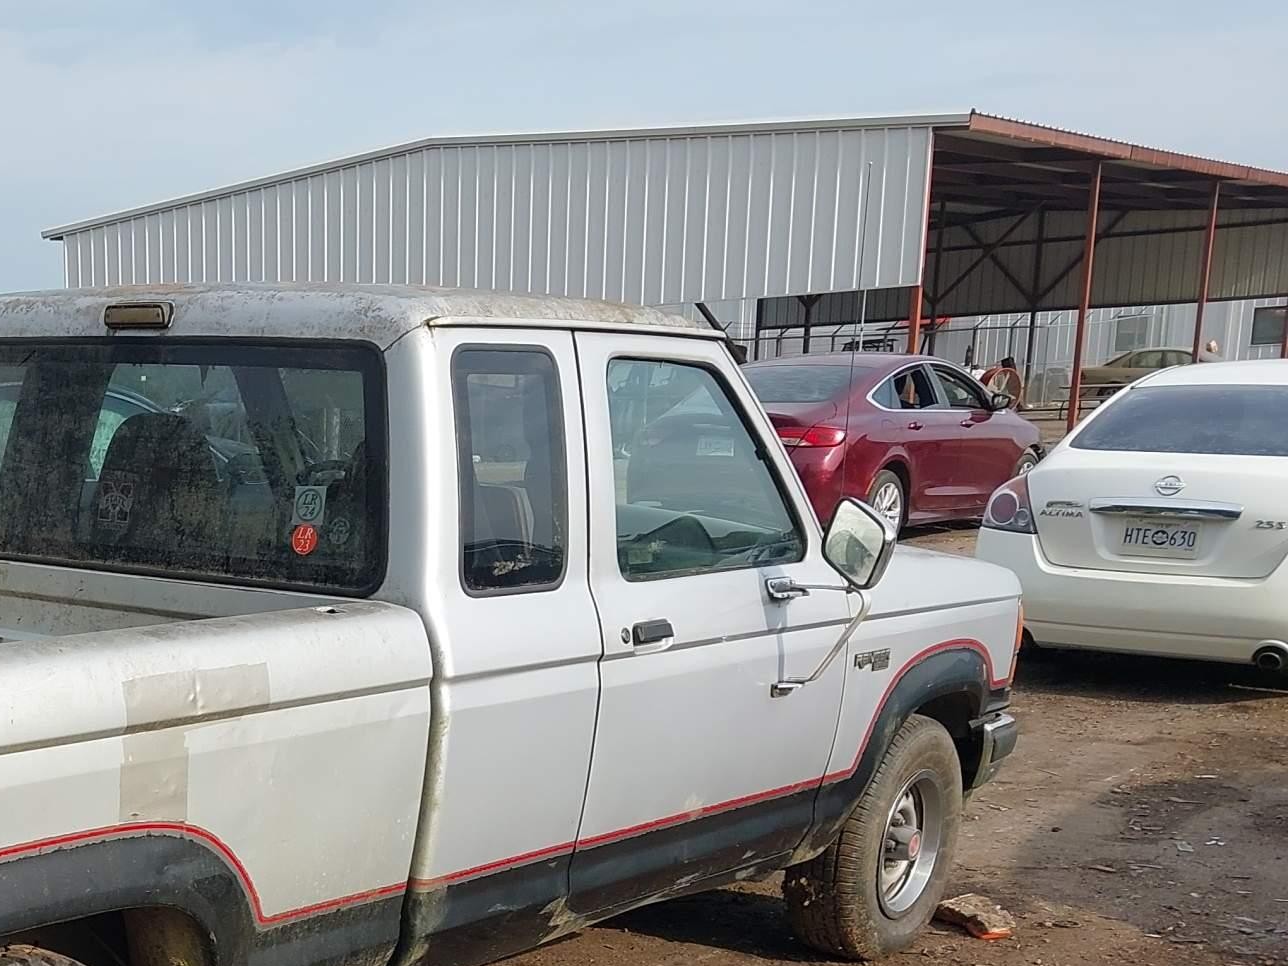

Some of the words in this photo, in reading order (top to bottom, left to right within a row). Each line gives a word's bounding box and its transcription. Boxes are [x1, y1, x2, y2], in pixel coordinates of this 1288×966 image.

[303, 493, 318, 505] LR
[302, 506, 316, 517] 24
[1039, 508, 1083, 518] ALTIMA
[297, 527, 314, 539] LR
[1123, 527, 1152, 545] HTE
[1169, 530, 1198, 547] 630
[296, 539, 311, 551] 23
